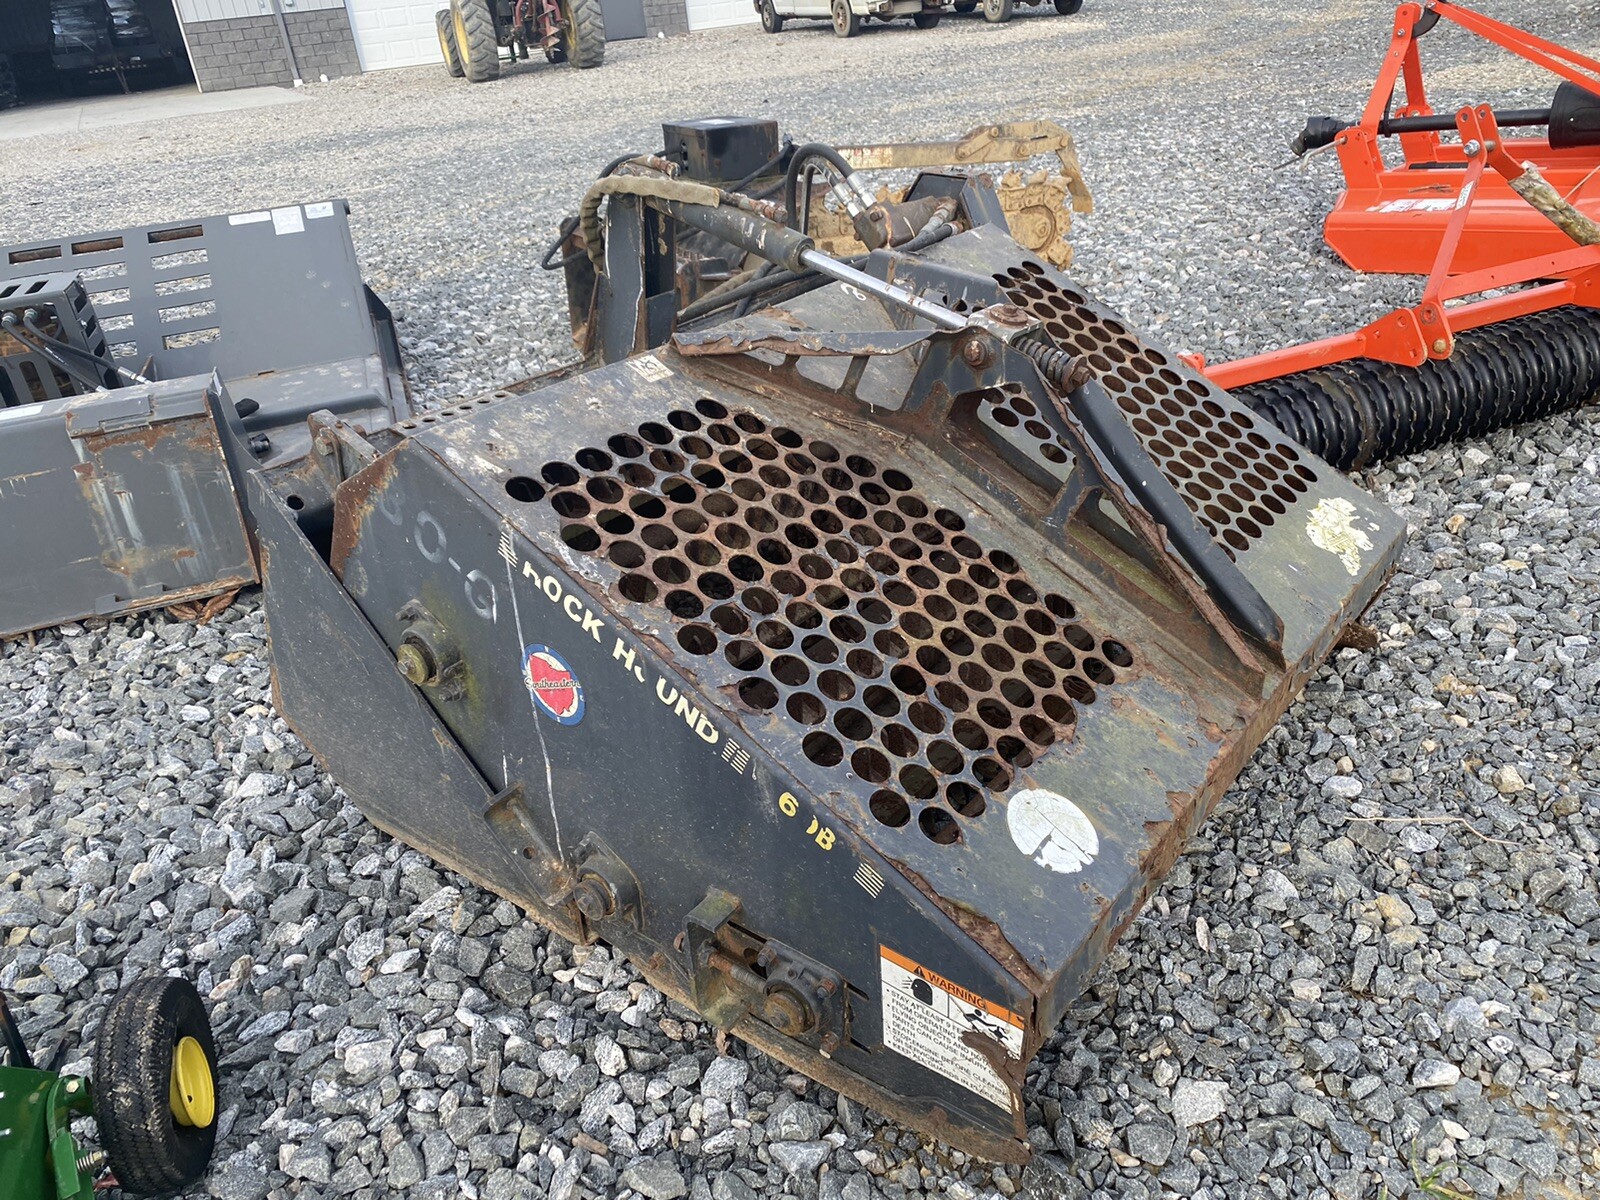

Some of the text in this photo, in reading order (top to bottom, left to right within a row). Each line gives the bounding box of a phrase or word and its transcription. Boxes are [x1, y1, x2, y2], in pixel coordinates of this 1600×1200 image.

[524, 676, 582, 691] Southeastern
[891, 990, 909, 1005] STAY
[921, 1007, 944, 1025] LEAST
[929, 971, 987, 1009] WARNING
[891, 998, 955, 1039] FROM OPERATING
[892, 1013, 914, 1030] PARTS
[916, 1026, 931, 1040] CAN
[933, 1036, 957, 1055] CAUSE
[918, 1020, 950, 1044] OBJECTS
[953, 1040, 968, 1053] AND
[893, 1041, 910, 1055] KEEP
[928, 1060, 958, 1080] GUARDS
[912, 1039, 938, 1057] ENGINE
[941, 1054, 970, 1075] BEFORE
